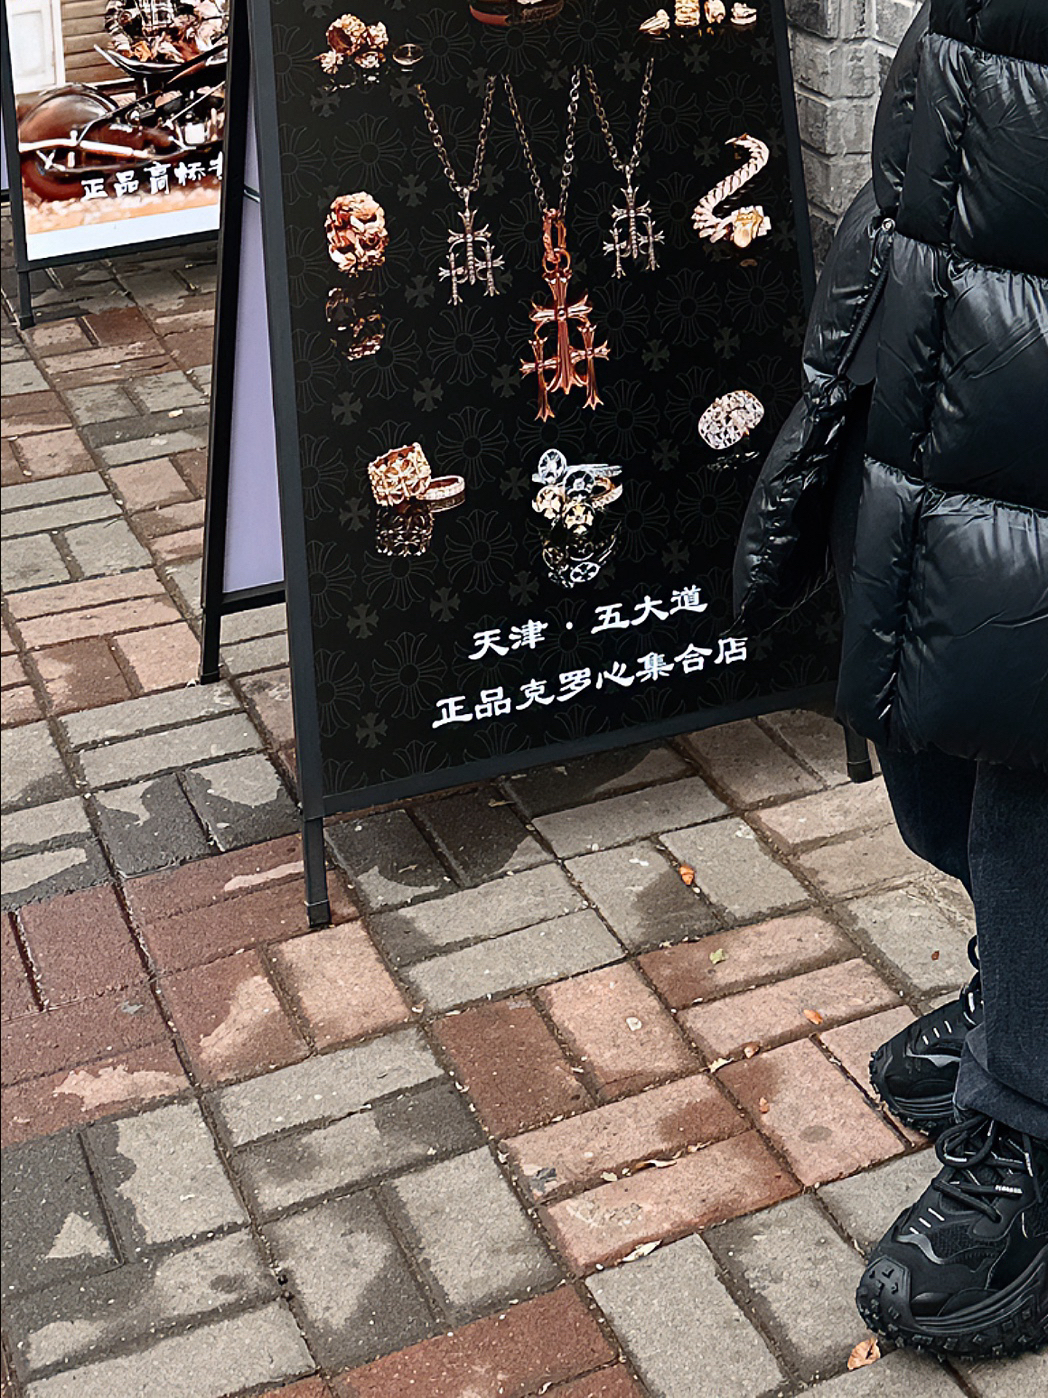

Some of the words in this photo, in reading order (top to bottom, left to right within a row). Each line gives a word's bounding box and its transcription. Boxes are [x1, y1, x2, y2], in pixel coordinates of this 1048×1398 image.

[431, 636, 750, 729] 正品克罗心集合店
